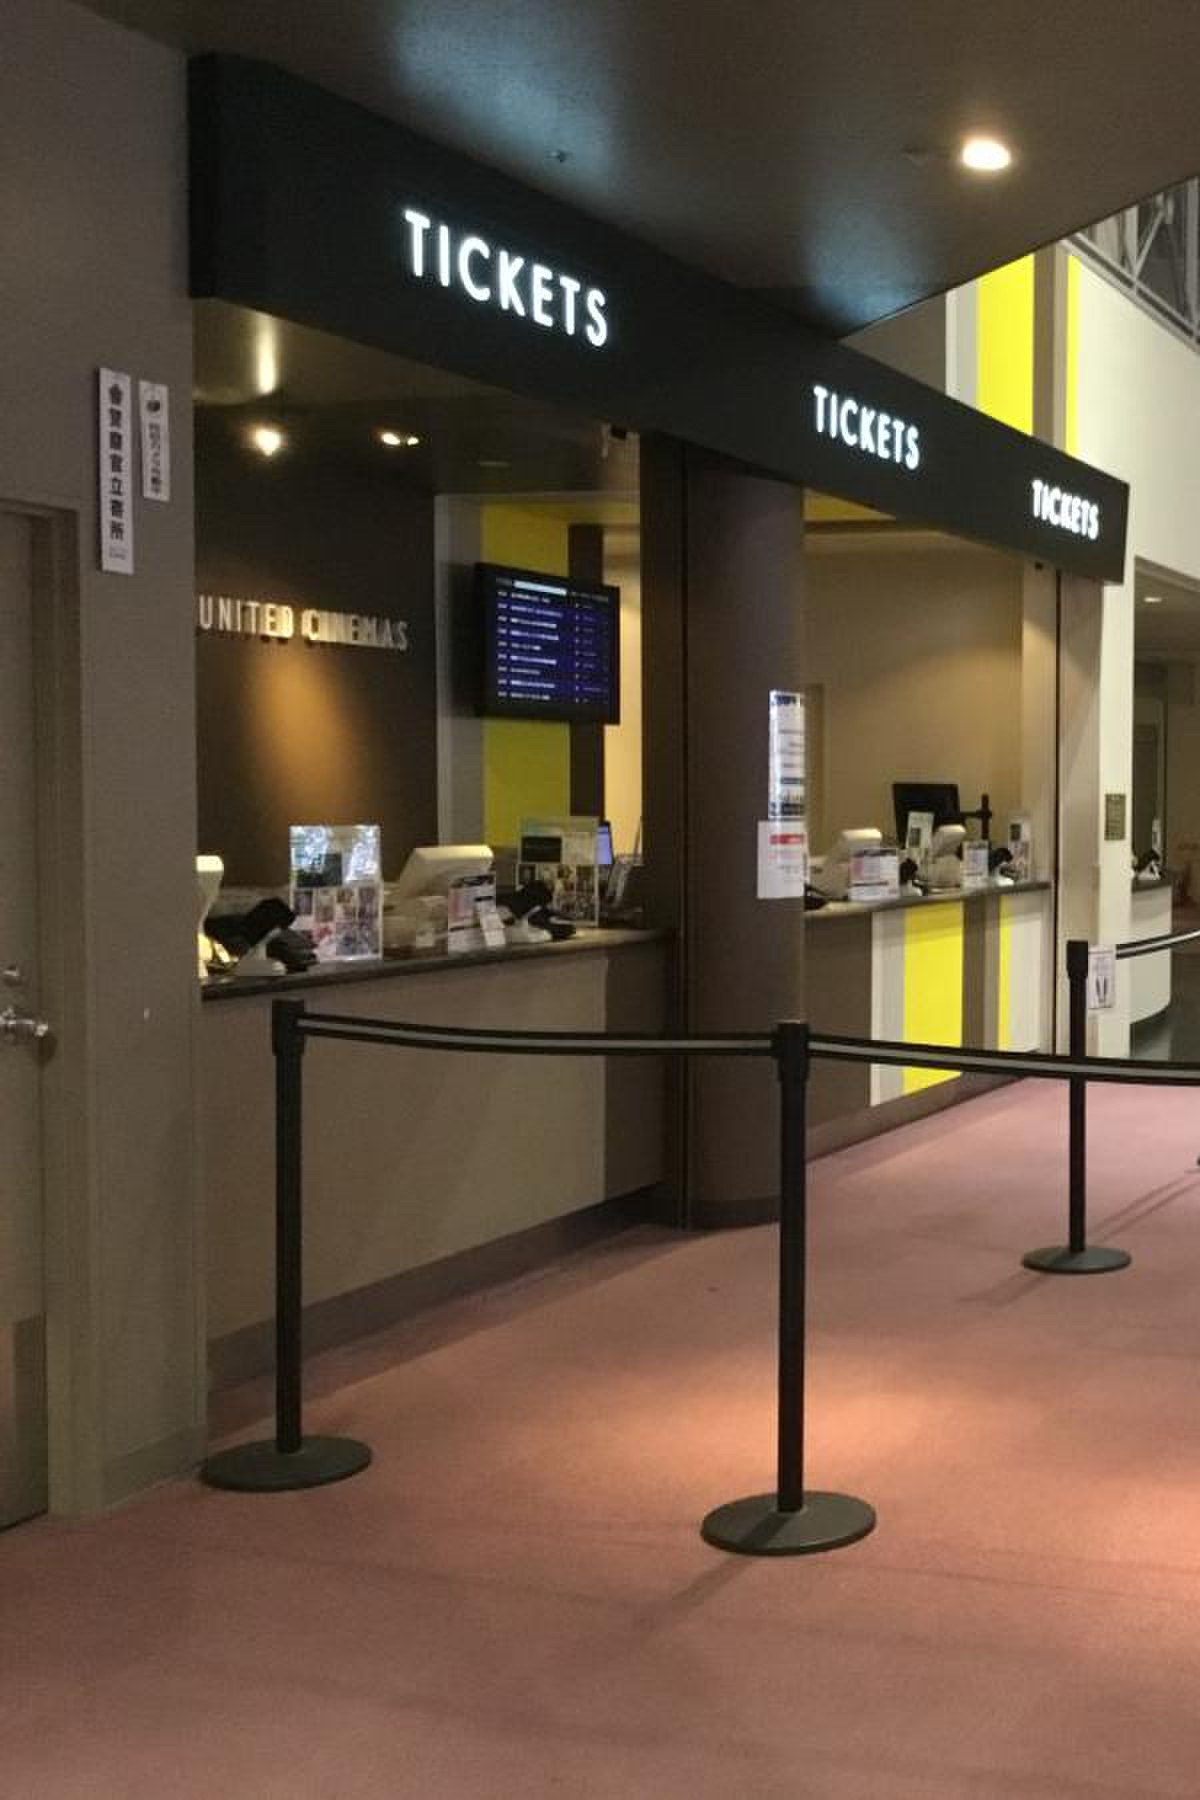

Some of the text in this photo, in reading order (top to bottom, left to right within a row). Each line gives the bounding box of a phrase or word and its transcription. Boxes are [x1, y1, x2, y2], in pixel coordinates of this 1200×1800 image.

[404, 208, 608, 347] TICKETS
[813, 384, 920, 471] TICKETS
[1031, 478, 1100, 541] TICKETS
[199, 595, 409, 651] UNITED CINEMAS
